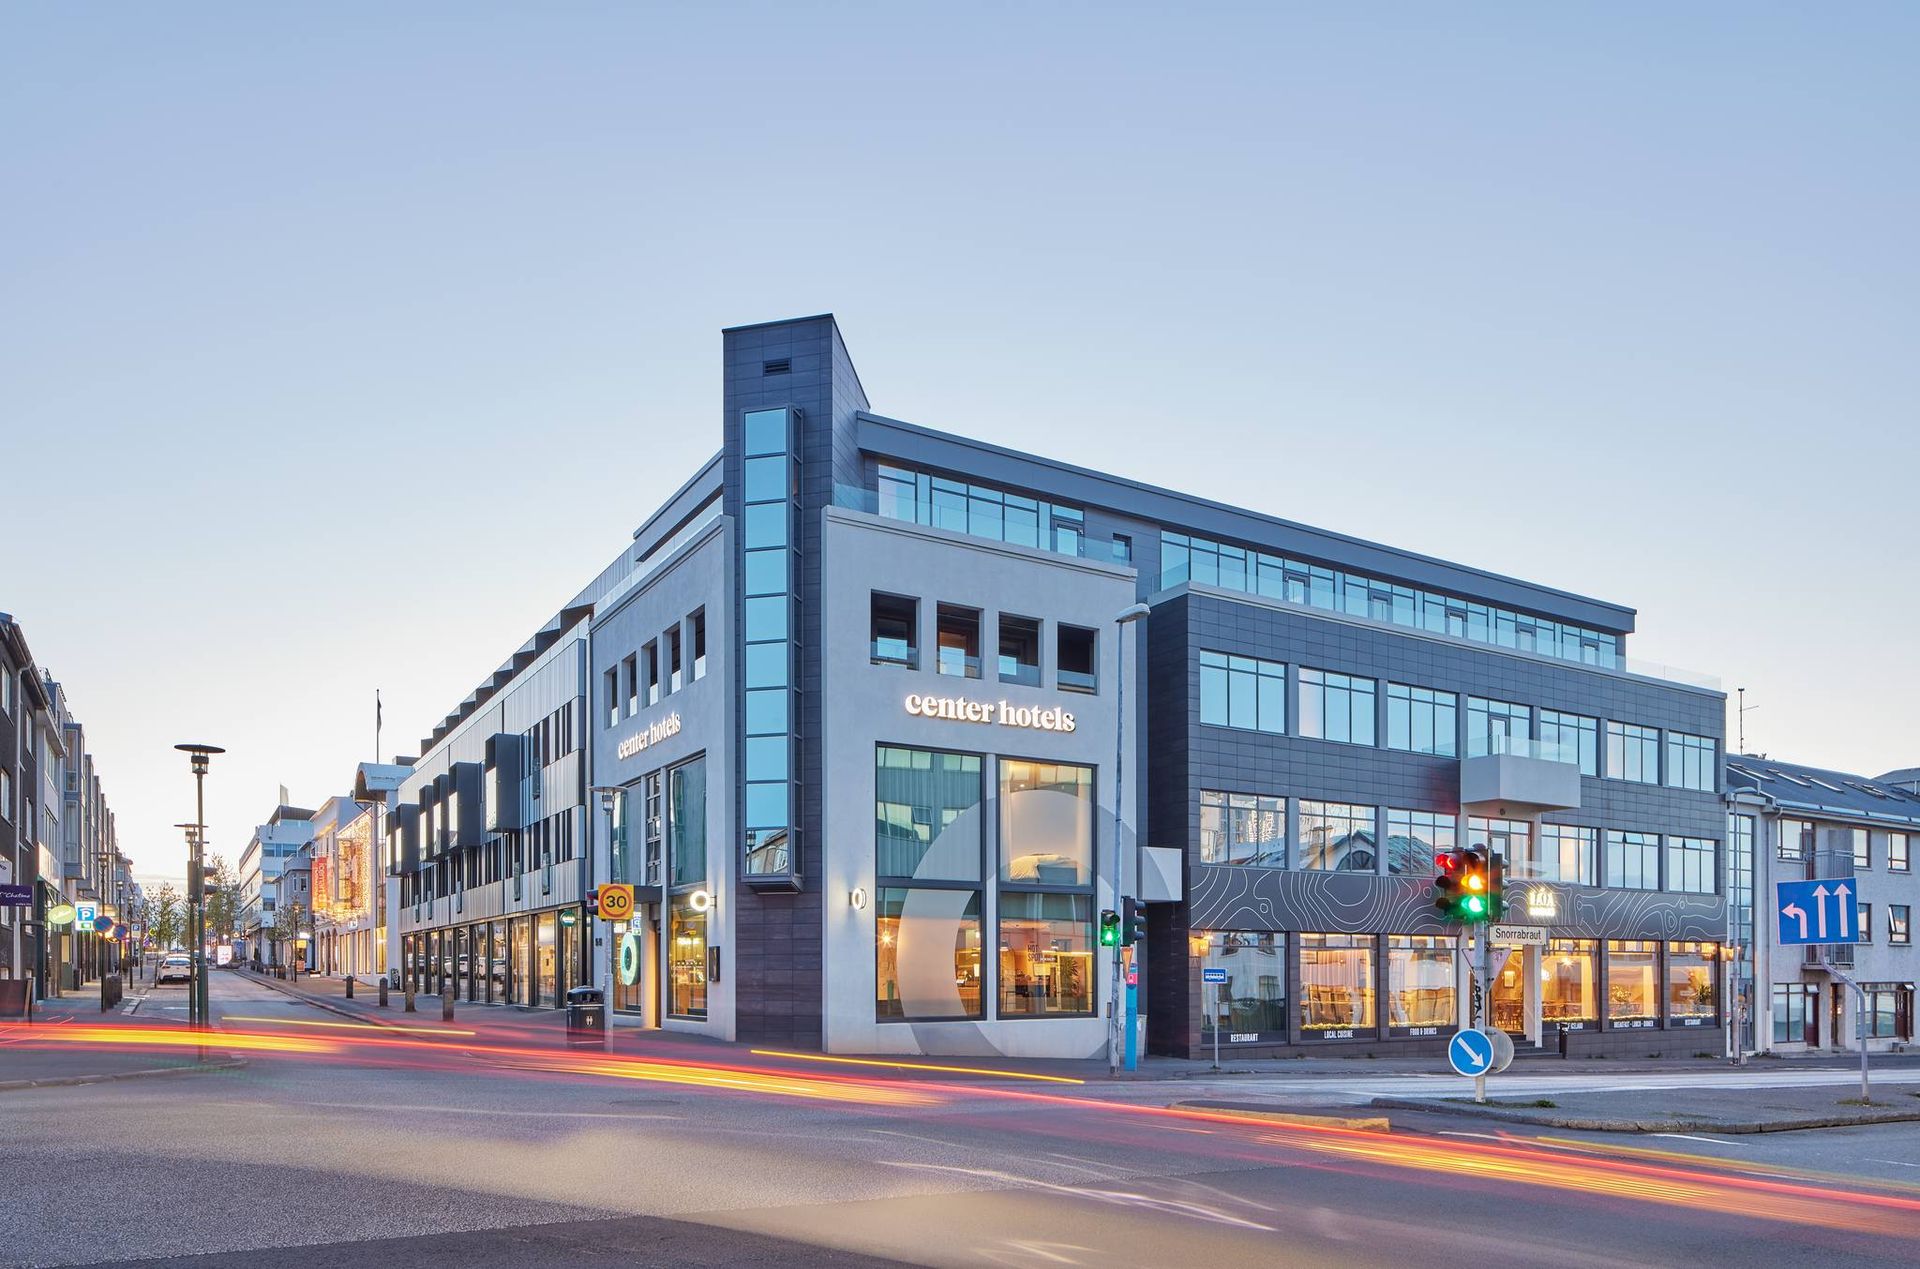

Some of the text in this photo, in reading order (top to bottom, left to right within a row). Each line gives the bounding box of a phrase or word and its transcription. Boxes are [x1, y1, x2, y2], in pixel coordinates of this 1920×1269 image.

[905, 694, 1076, 732] center hotels
[618, 711, 681, 760] center hotels
[605, 895, 627, 908] 30
[1495, 927, 1541, 940] Snorrabraut
[1230, 1033, 1259, 1043] RESTAURANT
[1324, 1030, 1353, 1039] LOCAL CUISINE
